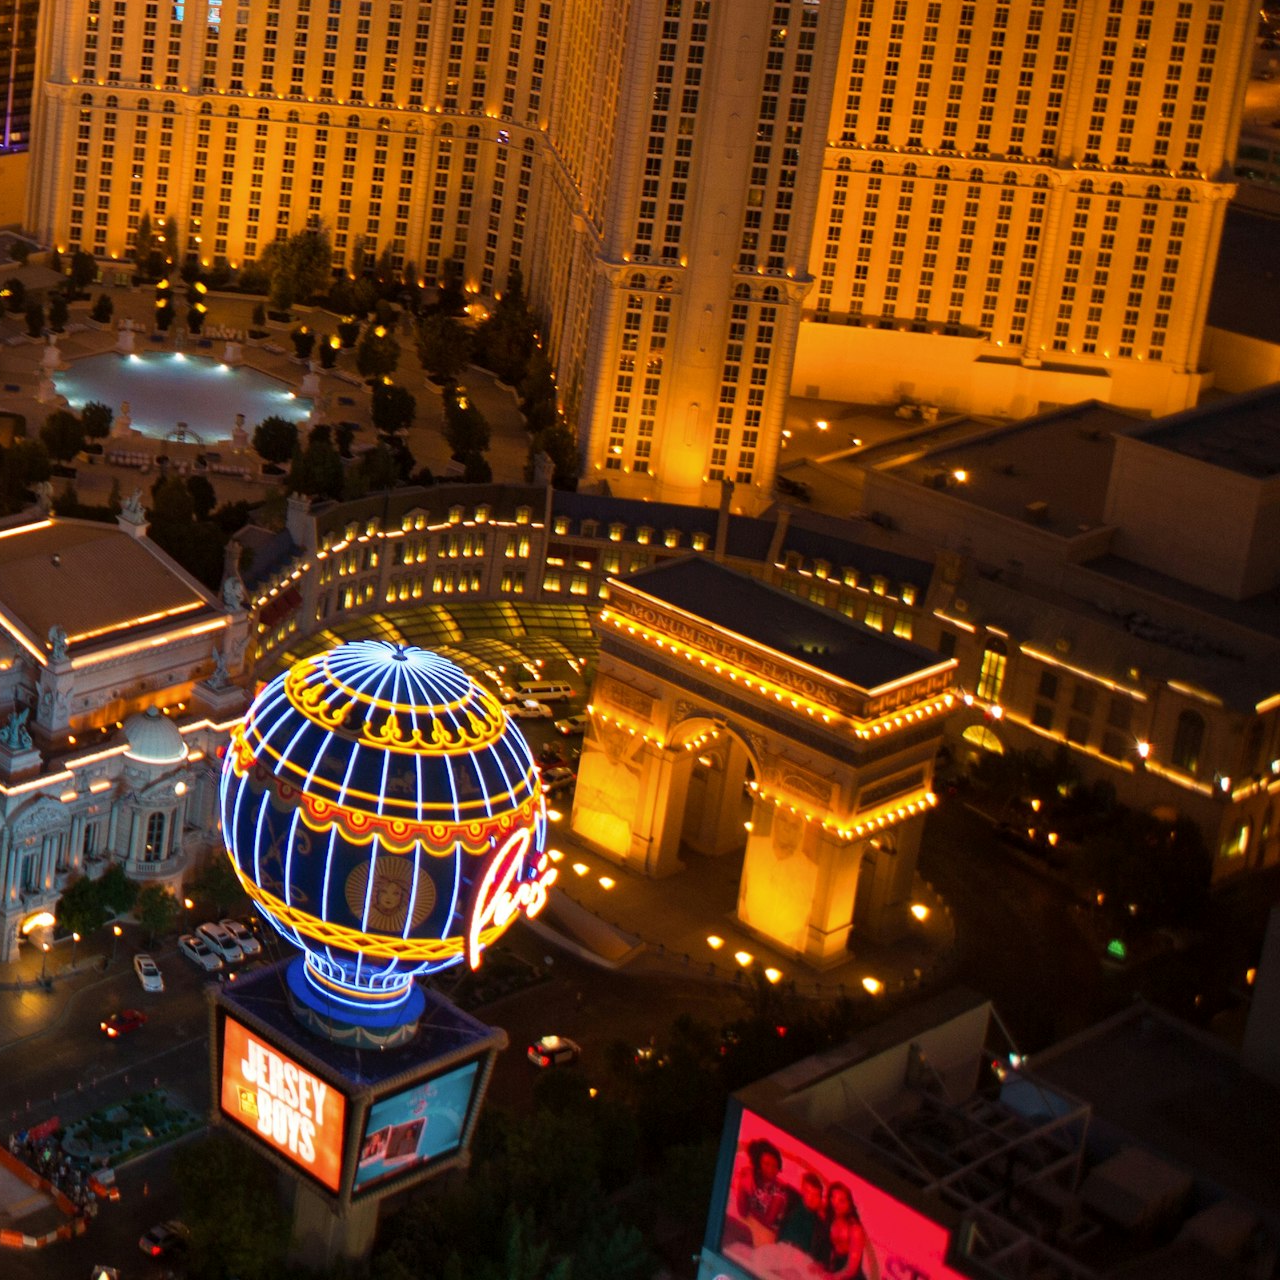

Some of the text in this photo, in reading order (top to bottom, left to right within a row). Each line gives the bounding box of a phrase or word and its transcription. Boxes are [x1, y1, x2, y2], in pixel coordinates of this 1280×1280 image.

[629, 602, 838, 705] MONUMENTAL FLAVORS
[469, 827, 558, 972] Paris
[241, 1038, 327, 1126] JERSEY
[257, 1087, 316, 1164] BOYS
